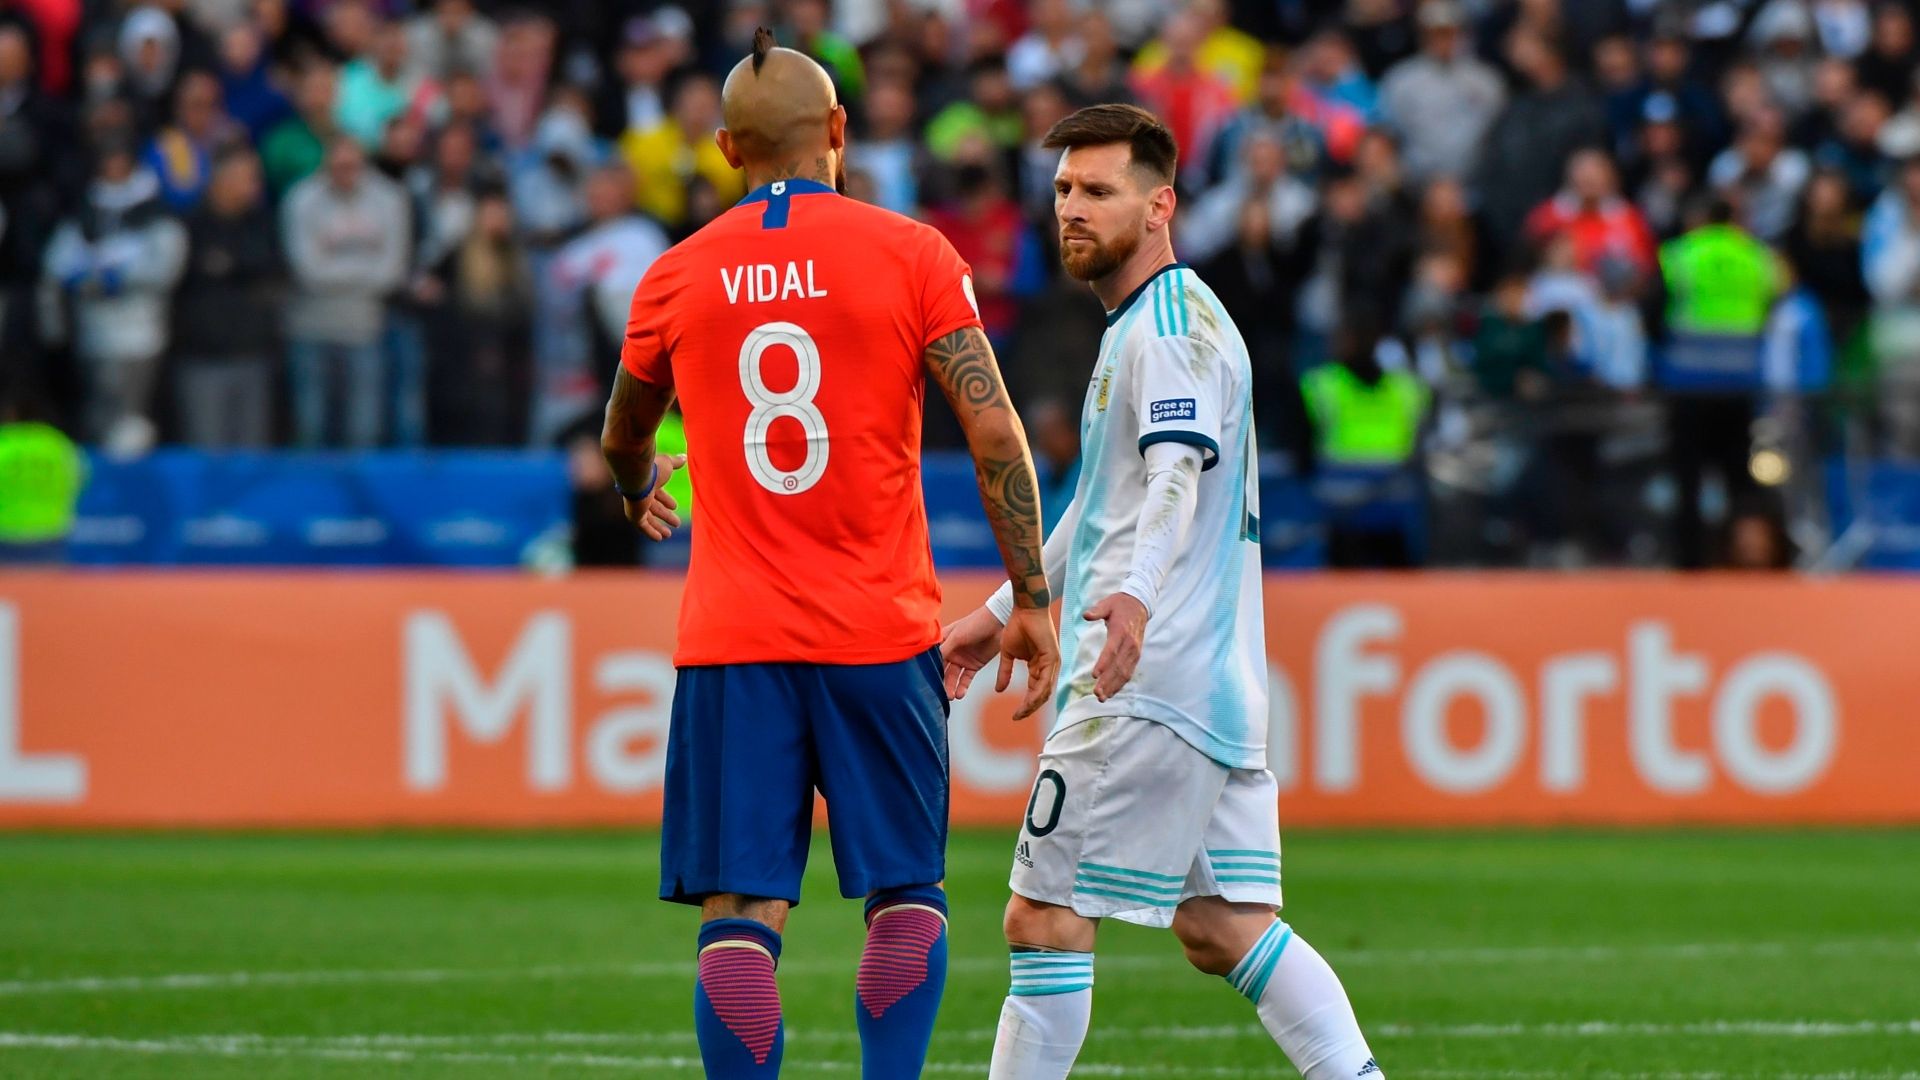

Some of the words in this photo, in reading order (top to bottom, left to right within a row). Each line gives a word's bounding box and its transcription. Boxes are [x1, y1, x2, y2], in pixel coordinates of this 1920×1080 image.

[720, 259, 828, 305] VIDAL
[738, 321, 830, 496] 8
[1152, 402, 1177, 412] Cree
[1178, 401, 1193, 409] en
[1152, 408, 1191, 421] grande
[404, 609, 677, 796] Ma
[947, 600, 1840, 796] cforto
